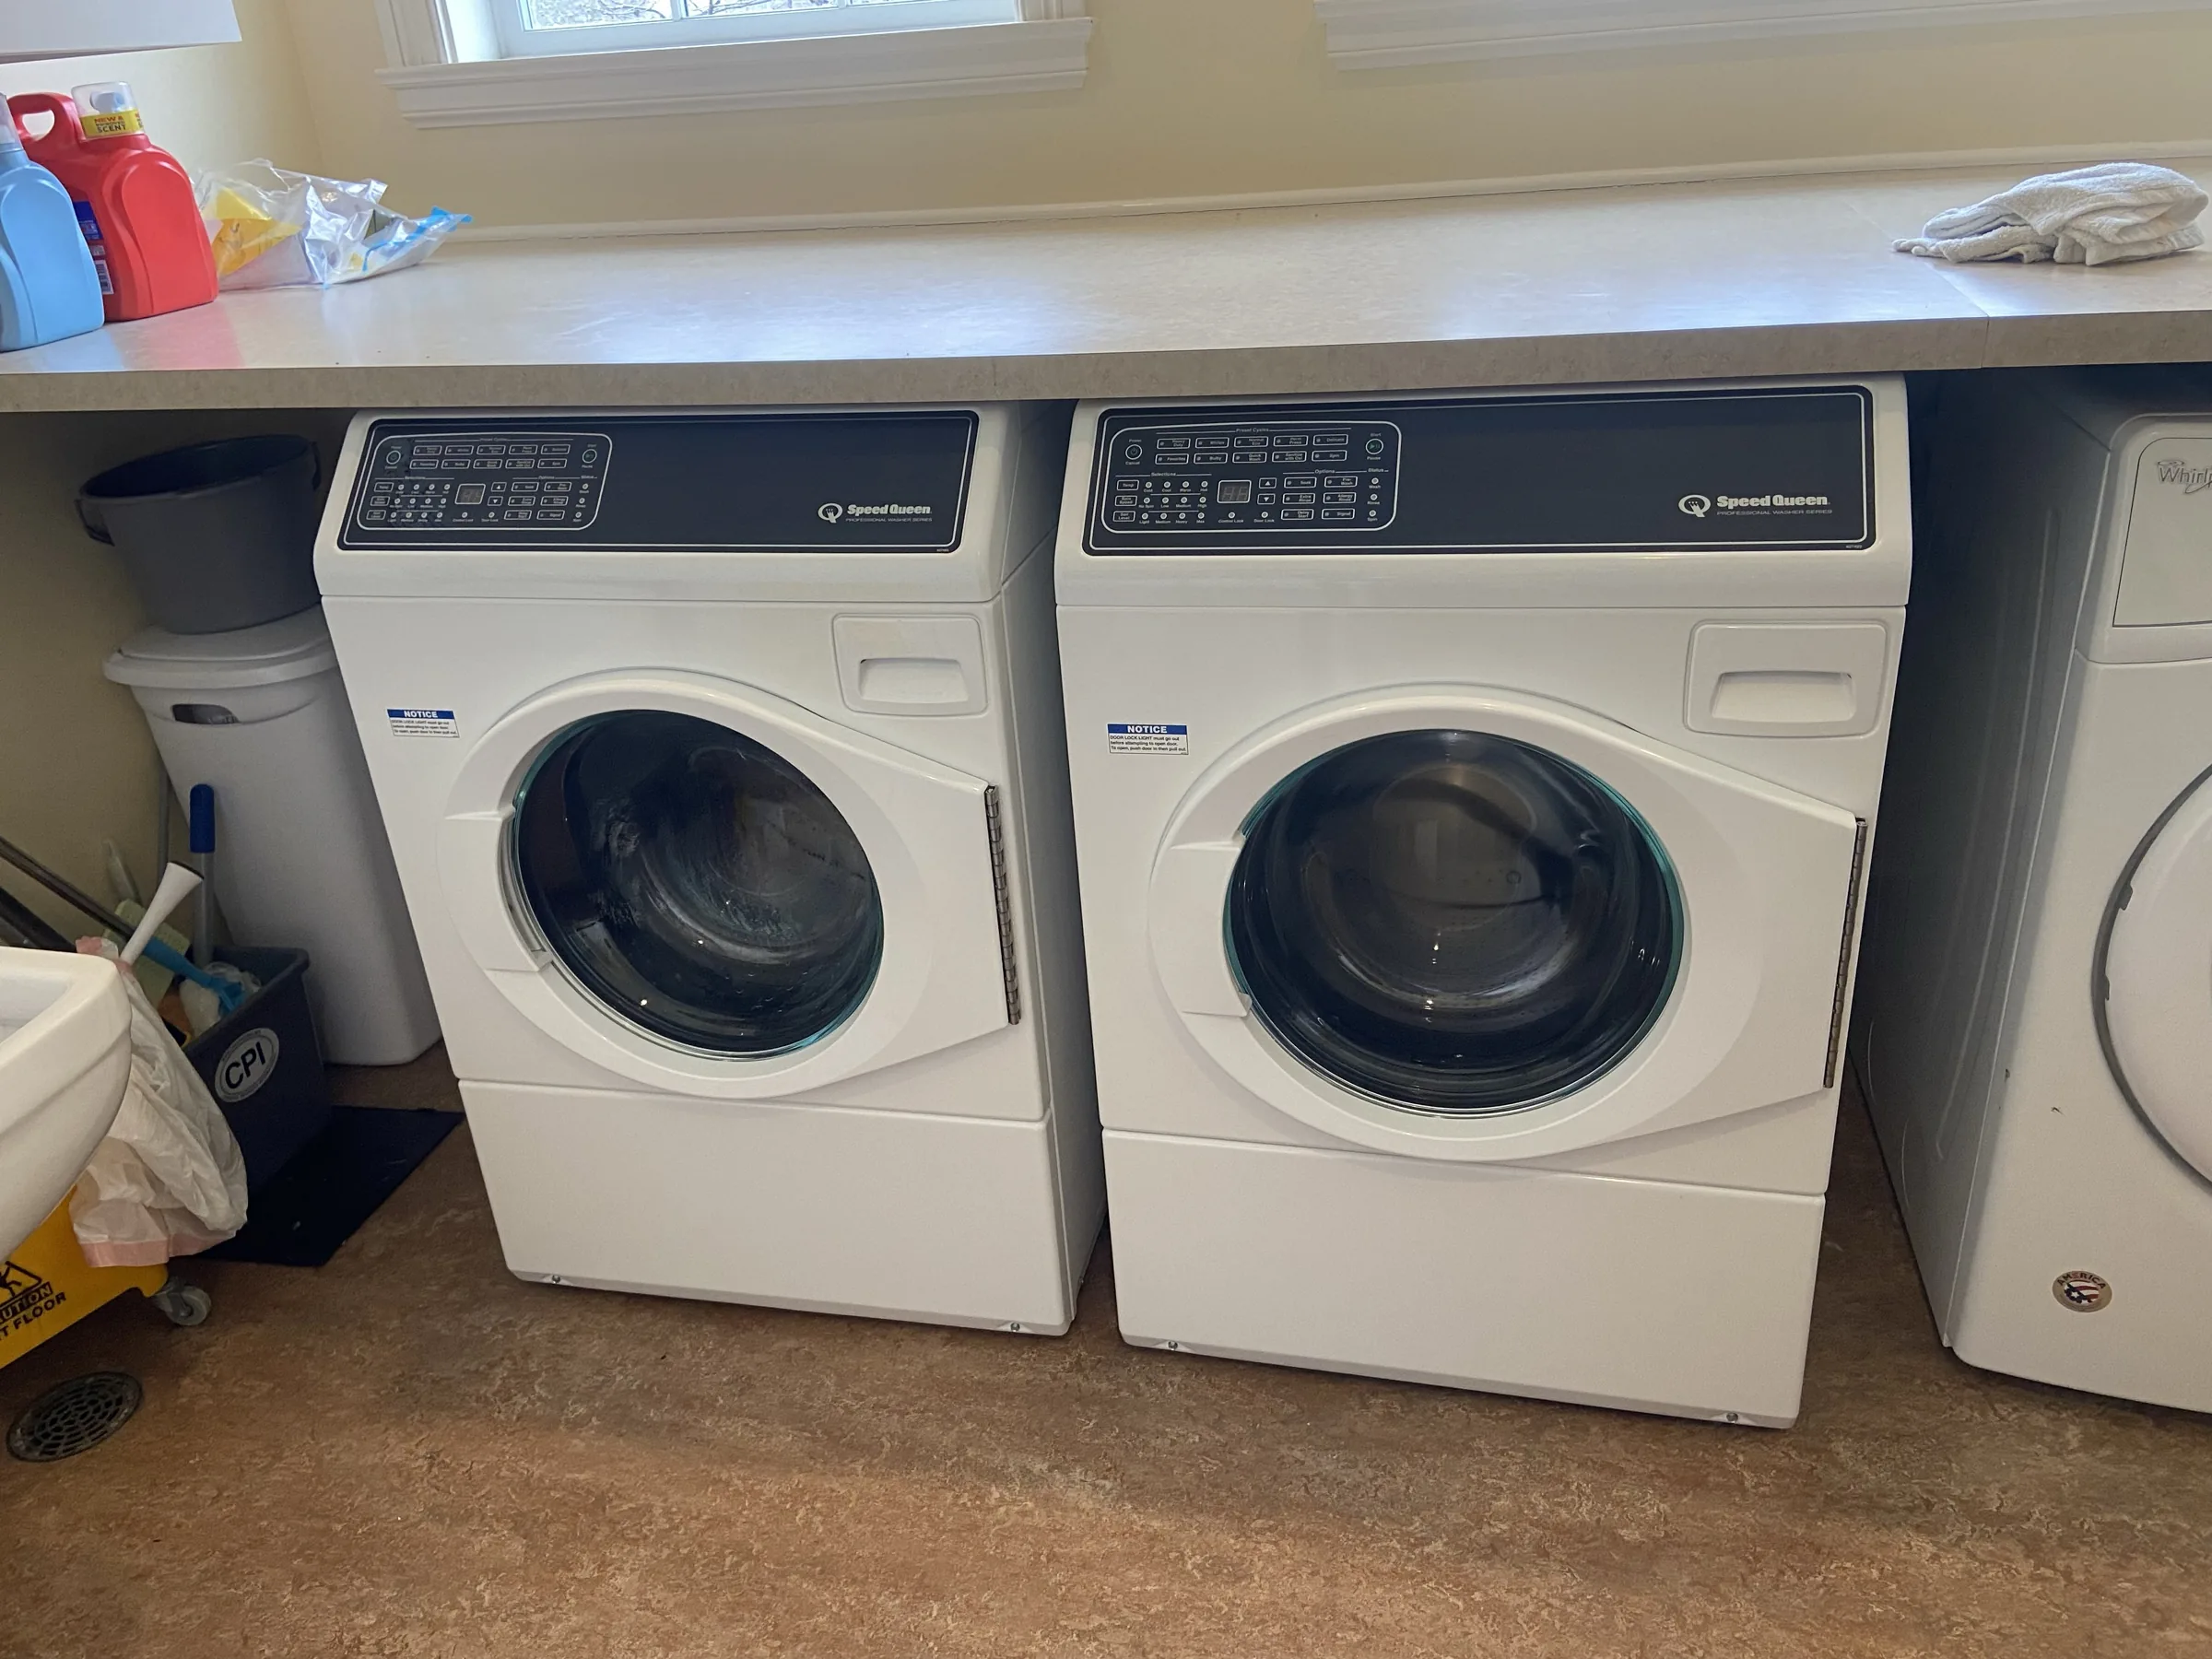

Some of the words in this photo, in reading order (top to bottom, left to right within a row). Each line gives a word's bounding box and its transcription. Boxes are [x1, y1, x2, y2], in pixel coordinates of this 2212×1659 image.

[98, 124, 125, 133] SCENT
[1716, 495, 1771, 509] Speed
[1772, 494, 1828, 506] Queen
[847, 504, 888, 516] Speed
[889, 504, 931, 514] Queen
[226, 1041, 265, 1088] CPI
[2057, 1273, 2106, 1288] AMERICA
[13, 1292, 66, 1330] FLOOR
